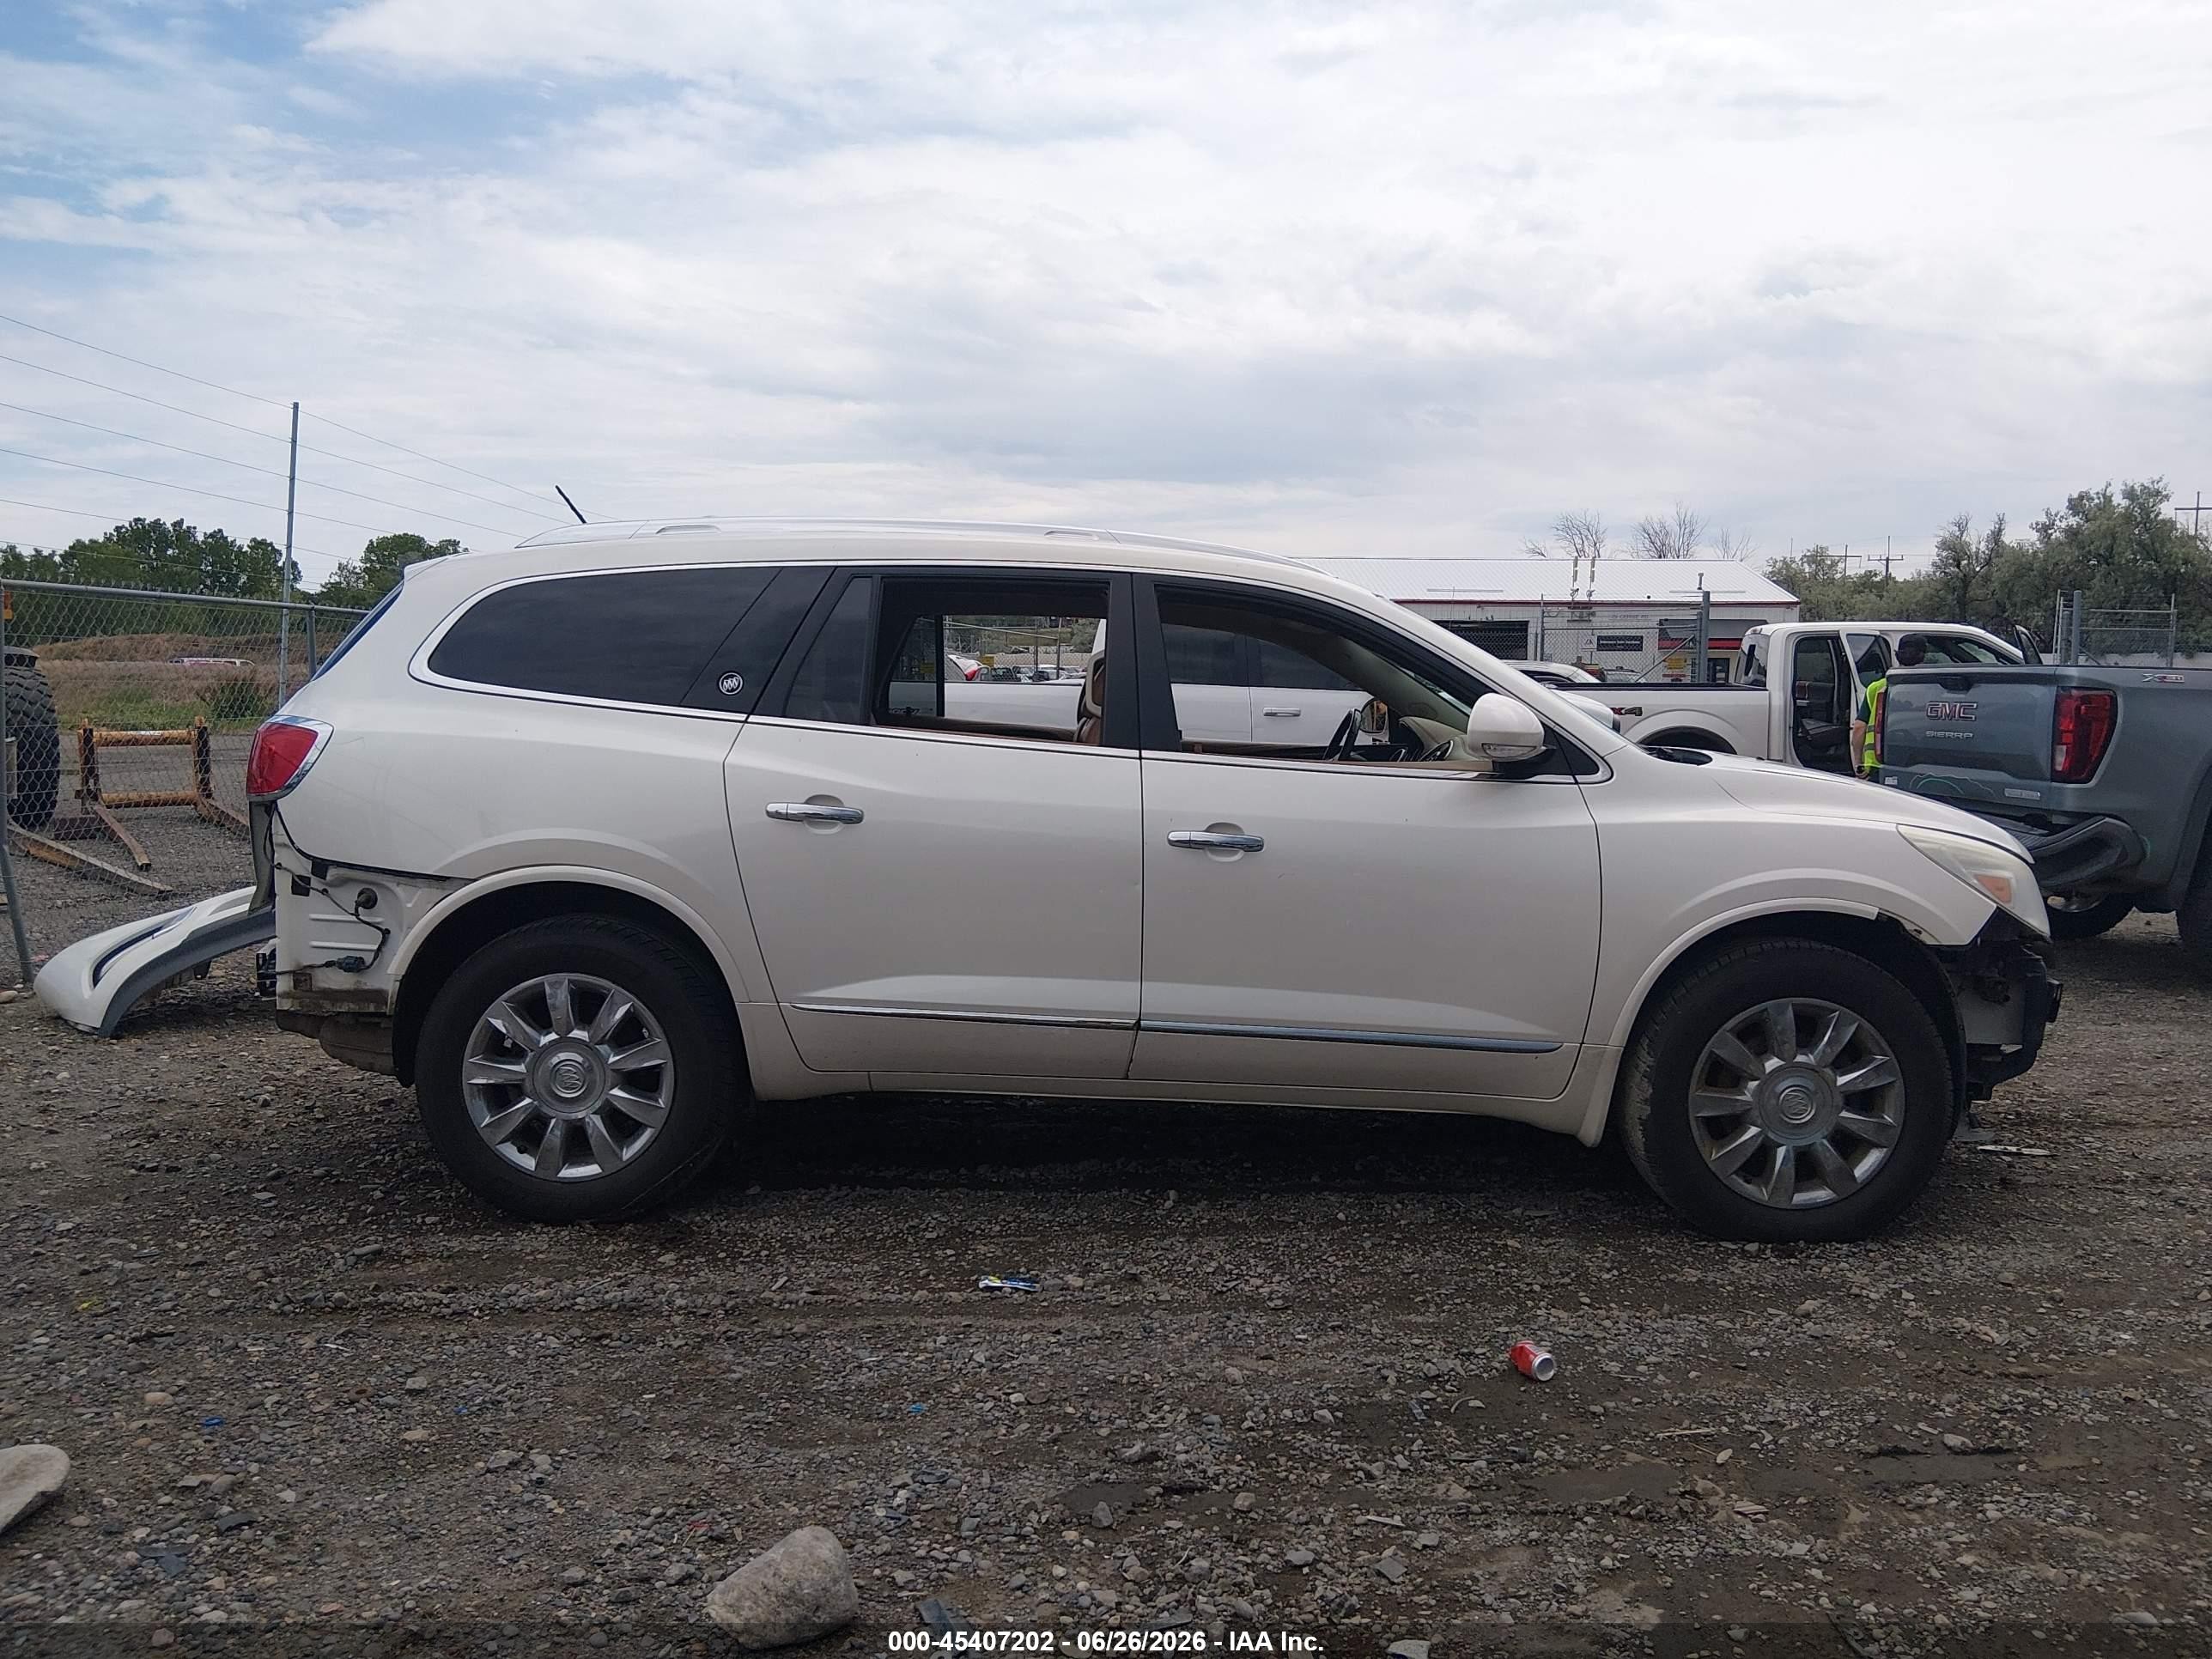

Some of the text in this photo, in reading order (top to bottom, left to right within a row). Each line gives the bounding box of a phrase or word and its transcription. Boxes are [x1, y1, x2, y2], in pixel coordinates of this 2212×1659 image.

[1609, 706, 1643, 716] X4
[1925, 701, 1978, 721] GMC
[1925, 731, 1974, 739] SIERRA
